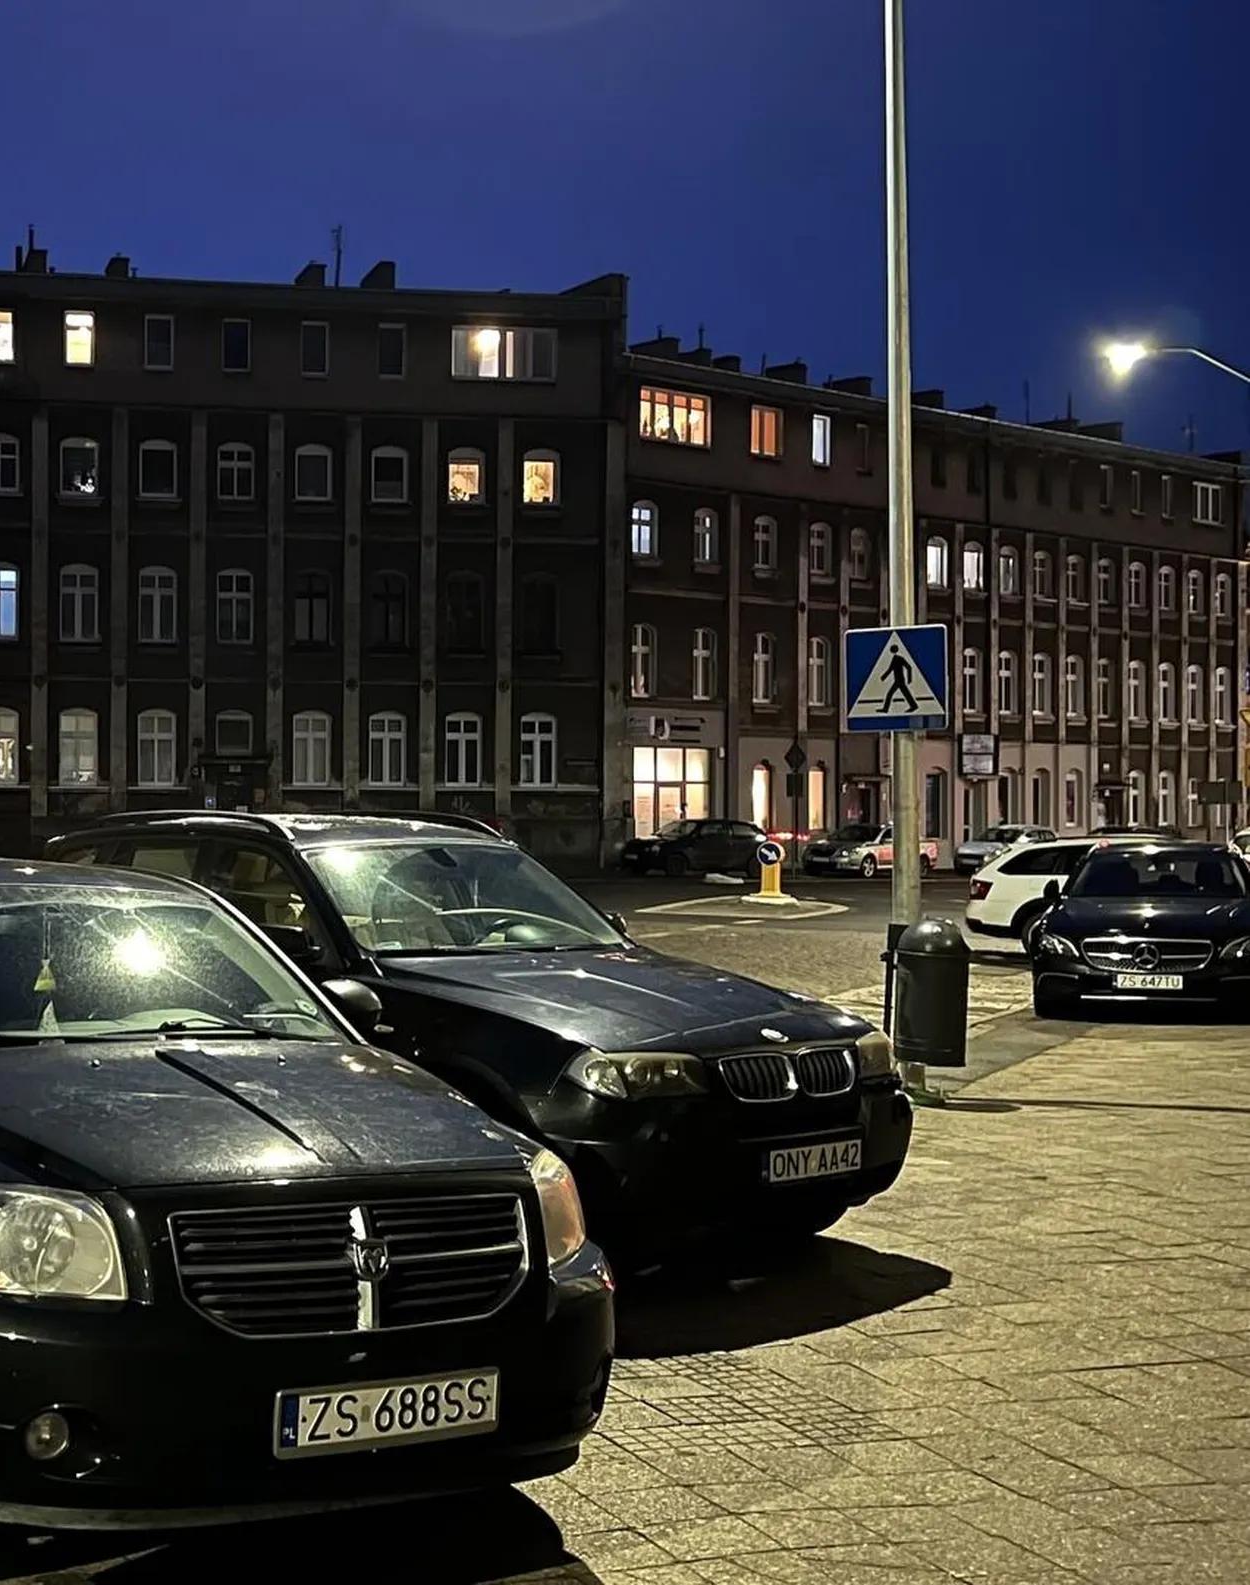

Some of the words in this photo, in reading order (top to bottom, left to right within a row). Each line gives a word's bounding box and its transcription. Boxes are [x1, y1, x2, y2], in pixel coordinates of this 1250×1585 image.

[772, 1149, 812, 1178] ONY
[817, 1143, 859, 1173] AA42
[307, 1394, 359, 1442] ZS
[374, 1377, 488, 1433] 688SS
[282, 1427, 296, 1440] PL
